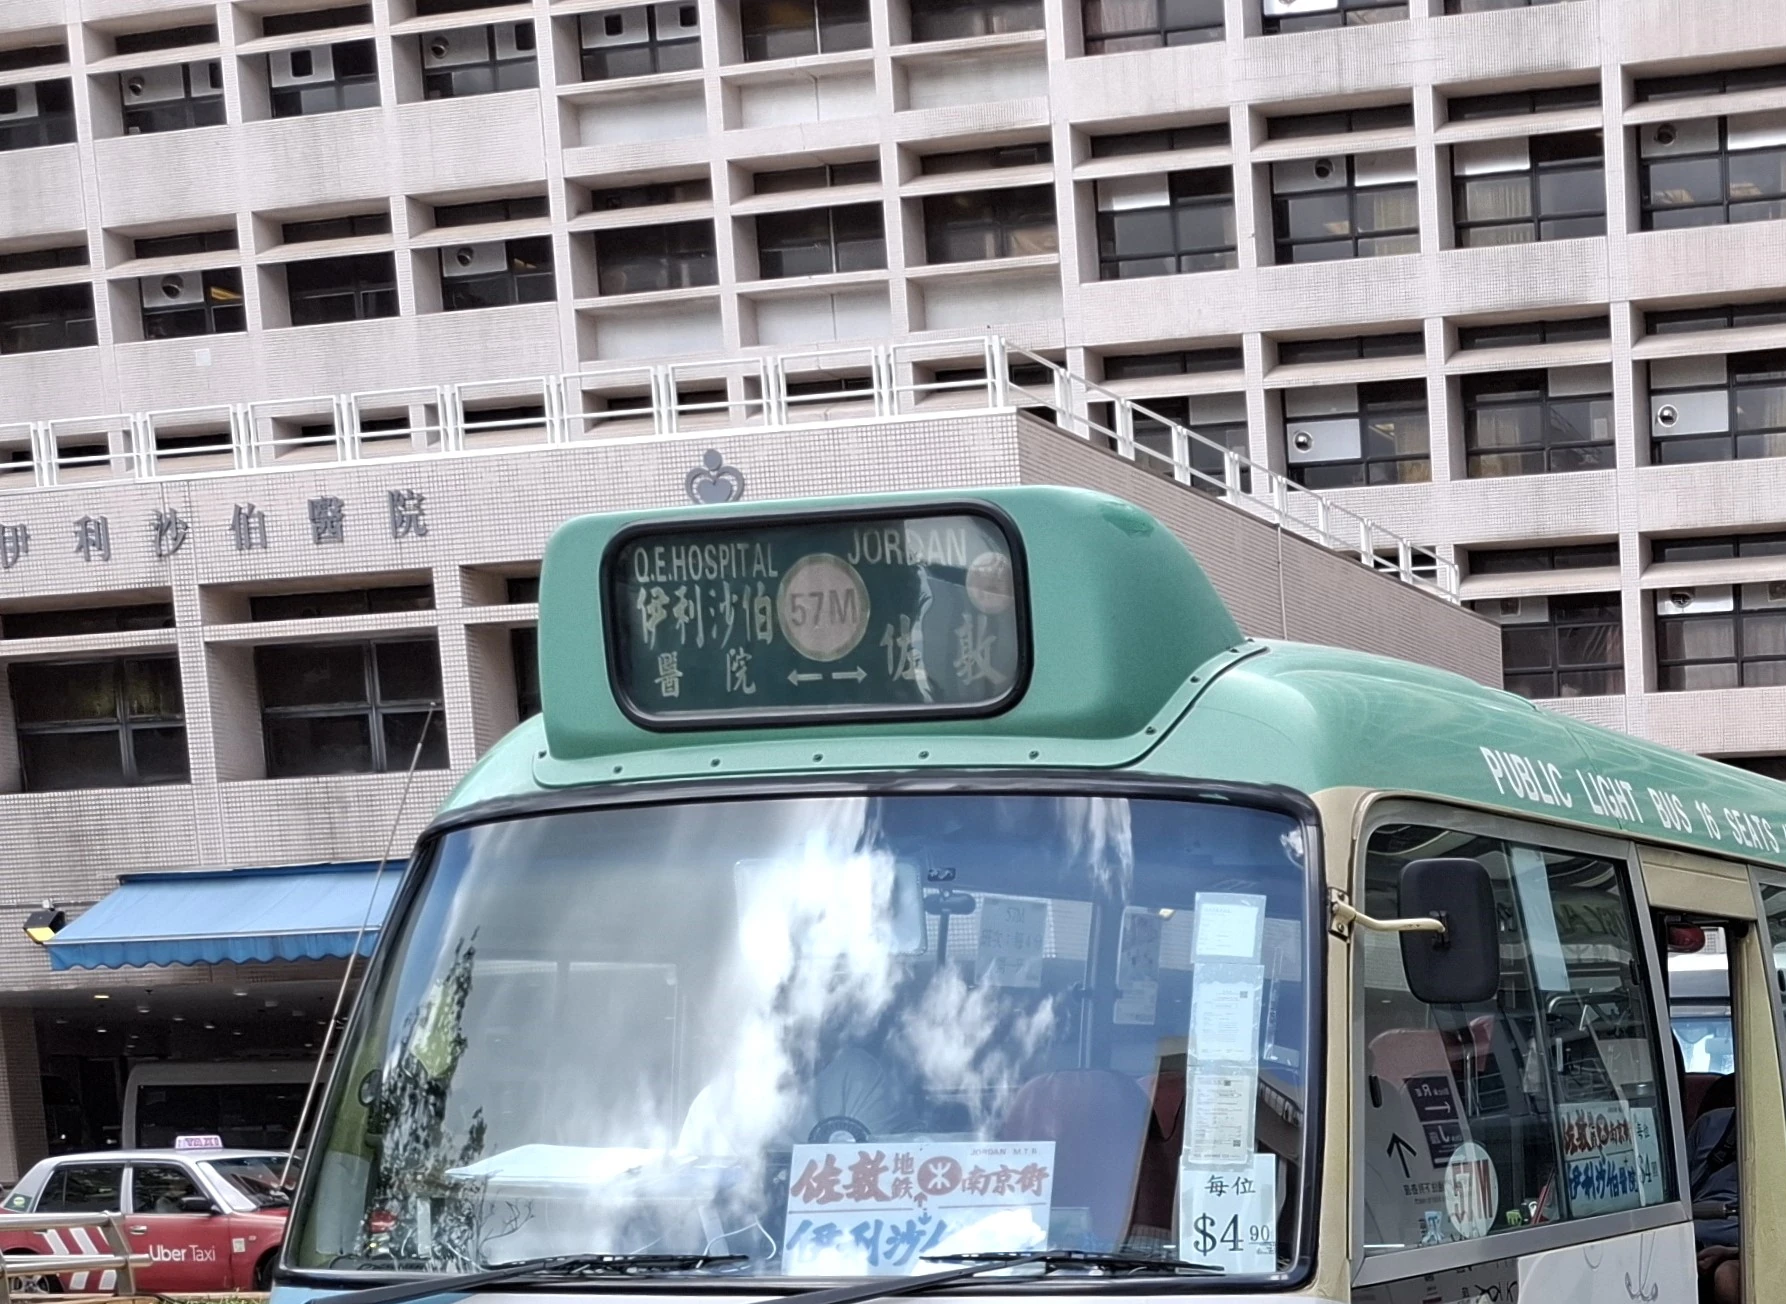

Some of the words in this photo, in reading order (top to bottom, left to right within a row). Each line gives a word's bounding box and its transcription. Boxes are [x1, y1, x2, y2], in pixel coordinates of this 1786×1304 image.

[0, 488, 429, 569] 伊利沙伯醫院
[847, 528, 968, 566] JORDAN
[635, 580, 774, 650] 伊利沙伯
[788, 586, 860, 628] 57M
[880, 612, 1007, 686] 佐敦
[653, 646, 757, 698] 醫院
[1479, 745, 1573, 809] PUBLIC
[1576, 768, 1647, 824] LIGHT
[1647, 786, 1693, 834] BUS
[1694, 799, 1722, 840] 16
[1724, 807, 1781, 854] SEATS
[790, 1150, 892, 1205] 佐敦
[962, 1163, 1050, 1197] 南京街
[1204, 1174, 1257, 1197] 每位
[149, 1245, 187, 1263] Uber
[189, 1244, 216, 1263] Taxi
